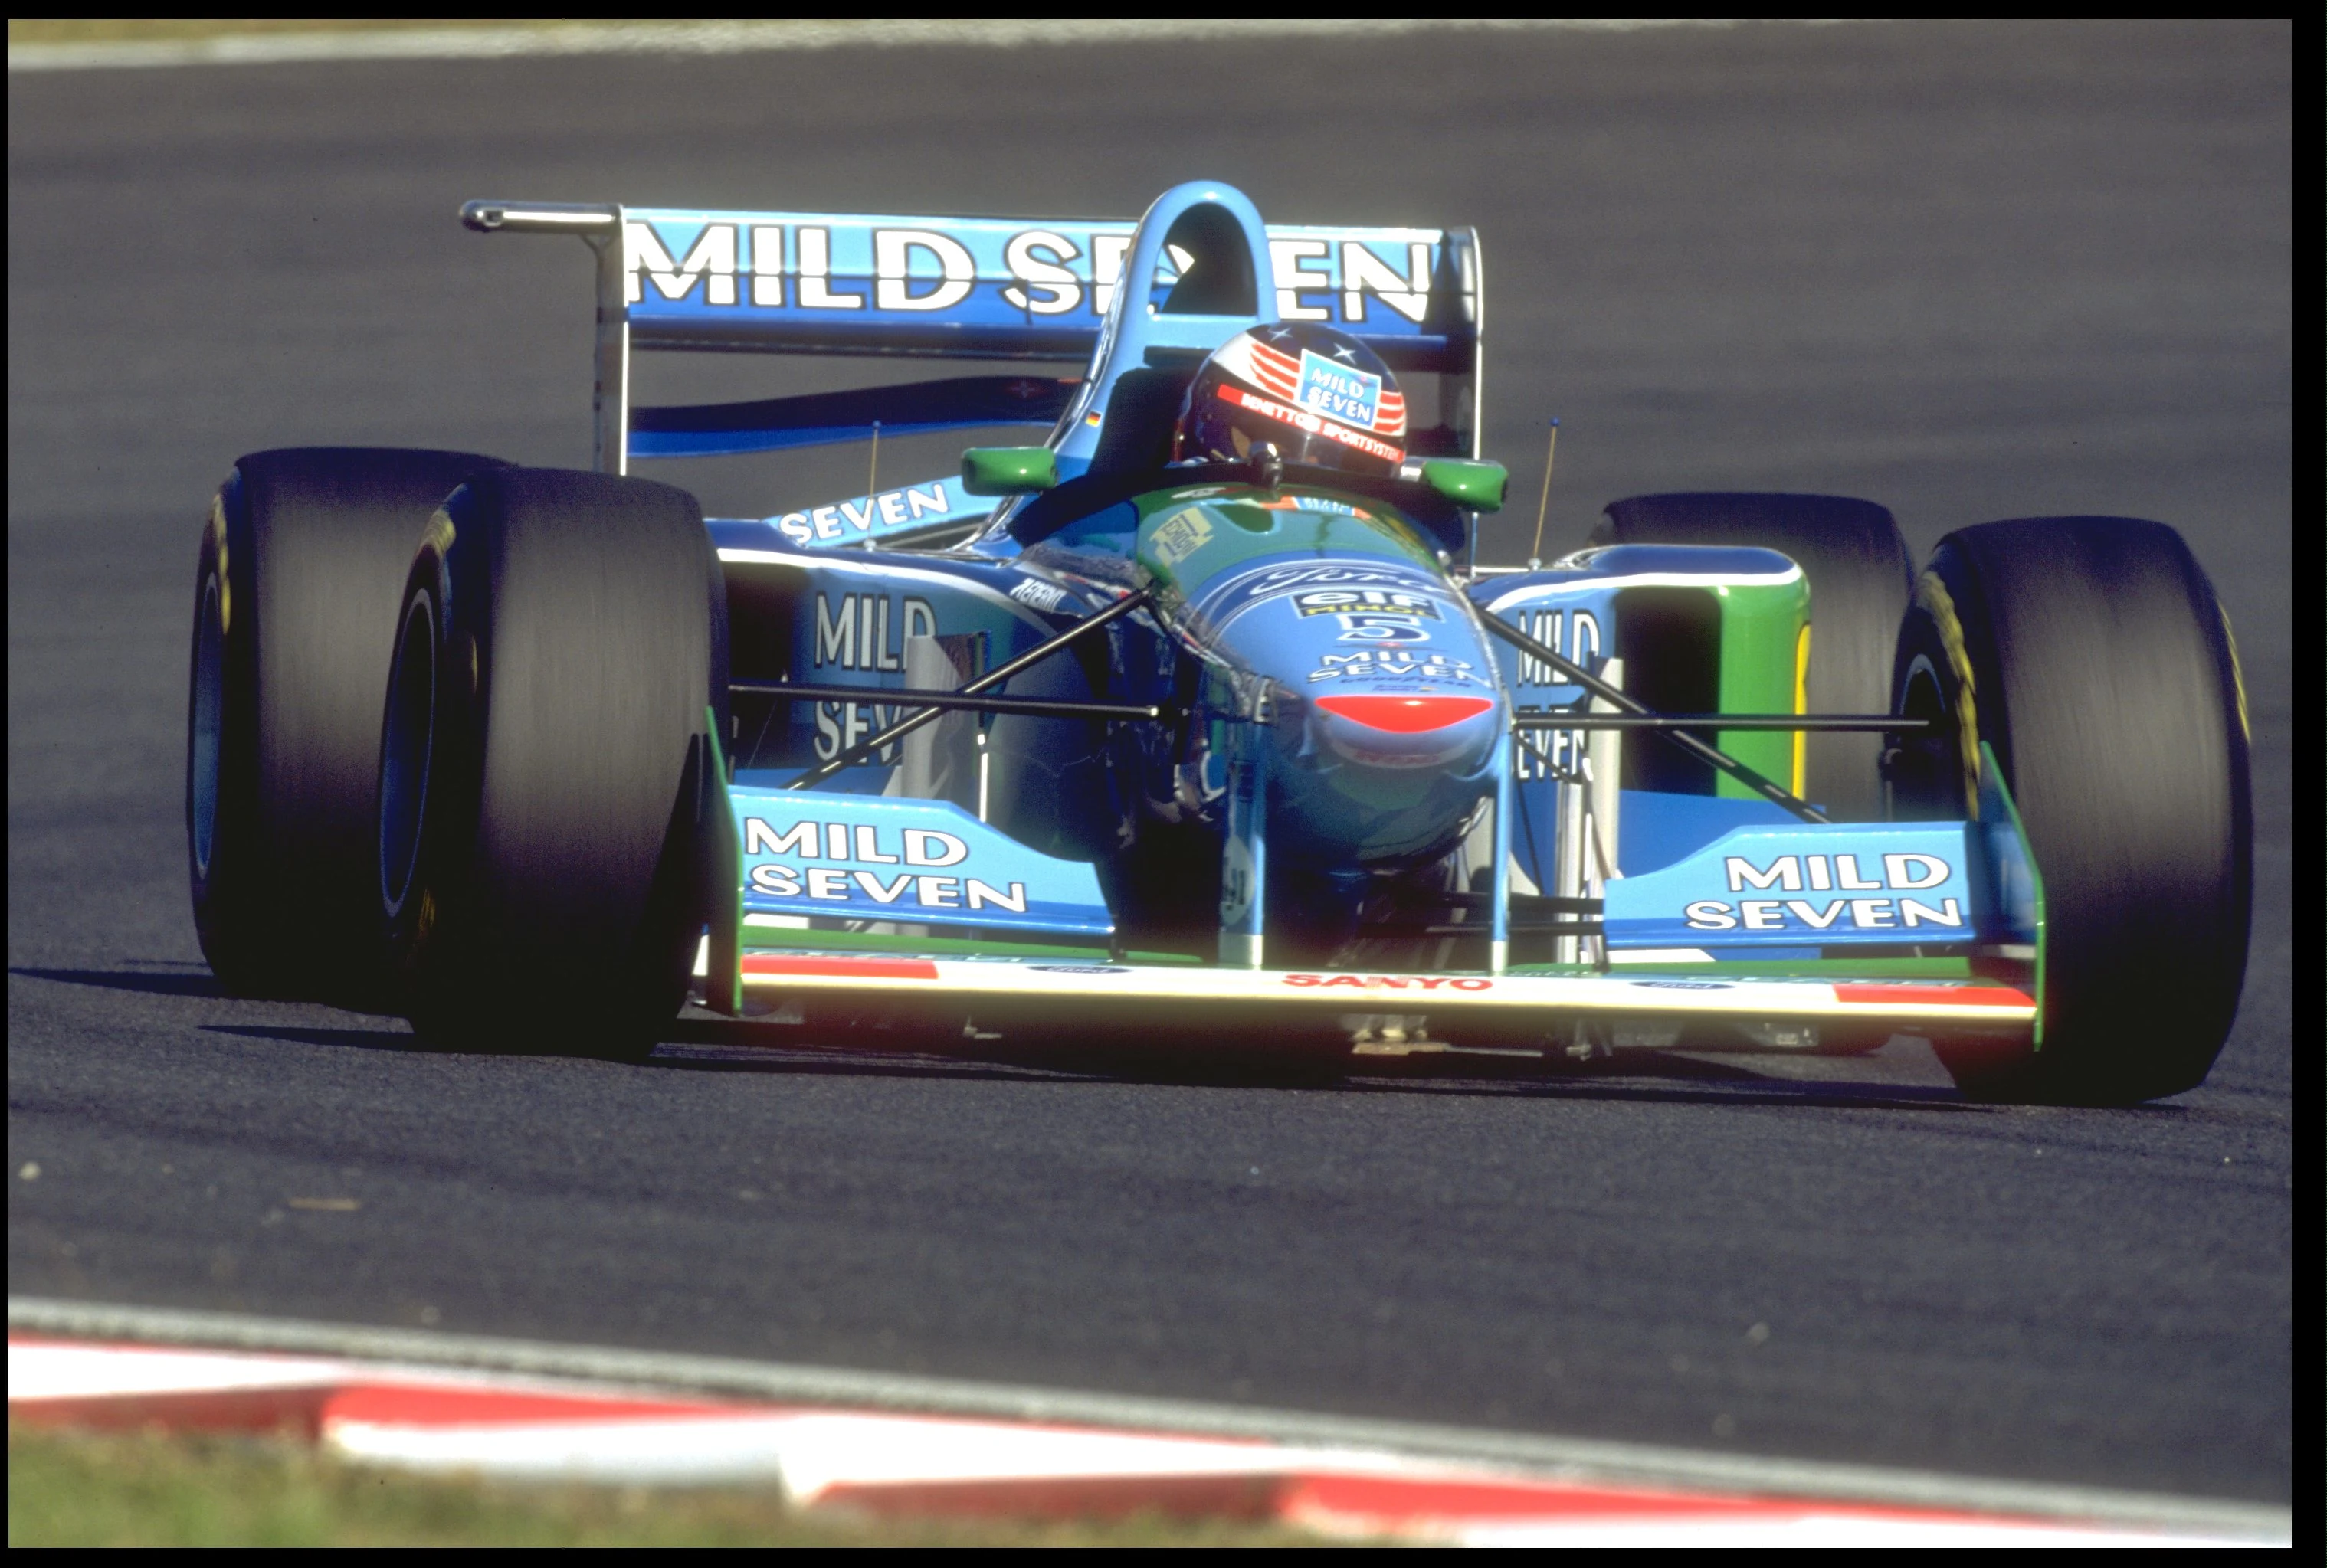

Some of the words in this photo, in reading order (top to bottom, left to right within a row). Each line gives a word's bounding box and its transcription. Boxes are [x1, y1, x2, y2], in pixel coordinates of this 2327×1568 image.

[624, 220, 977, 311] MILD
[998, 229, 1431, 322] SEEN
[1307, 385, 1372, 423] SEVEN
[1310, 367, 1365, 400] MILD
[1241, 391, 1322, 433] BENETTON
[778, 483, 950, 545] SEVEN
[1300, 591, 1430, 608] elf
[812, 590, 938, 673] MILD
[1336, 614, 1431, 642] 5
[1517, 609, 1601, 686] MILD
[1307, 663, 1495, 688] SEVEN
[1319, 650, 1475, 671] MILD
[814, 700, 903, 766] SEV
[1516, 705, 1586, 781] EVEN
[744, 817, 968, 867] MILD
[750, 864, 1027, 913] SEVEN
[1724, 853, 1952, 893] MILD
[1684, 898, 1965, 931] SEVEN
[1282, 974, 1494, 991] SANYO
